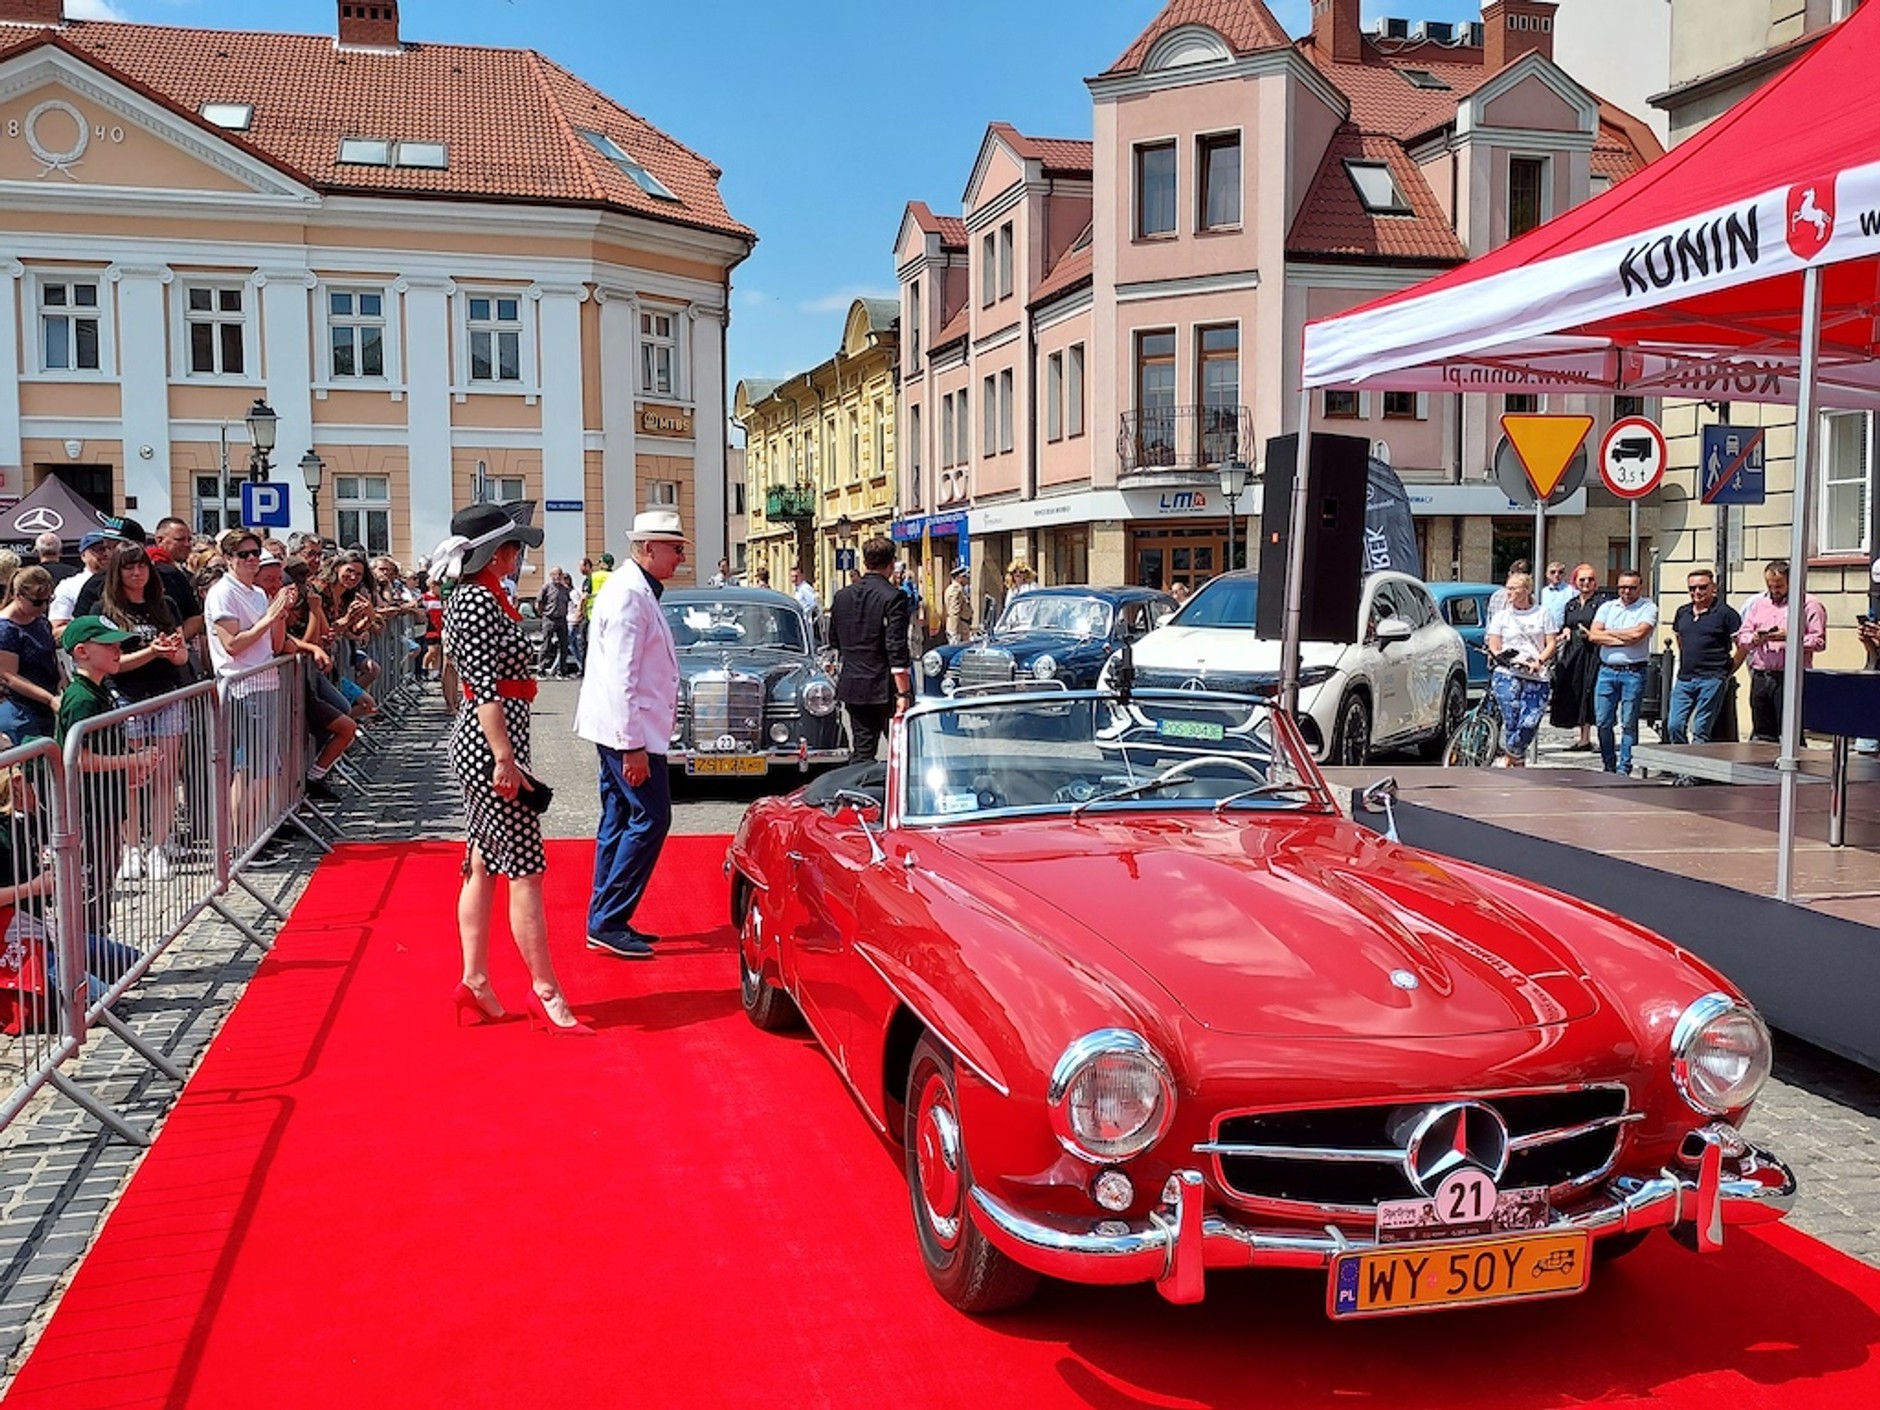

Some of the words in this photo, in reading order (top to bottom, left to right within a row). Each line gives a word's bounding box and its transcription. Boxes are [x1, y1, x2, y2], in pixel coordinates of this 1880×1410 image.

[1618, 203, 1759, 297] KONIN
[252, 486, 280, 522] P
[720, 737, 733, 749] 23
[1449, 1180, 1482, 1218] 21
[1339, 1290, 1356, 1302] PL
[1368, 1257, 1430, 1302] WY
[1446, 1246, 1525, 1295] 50Y
